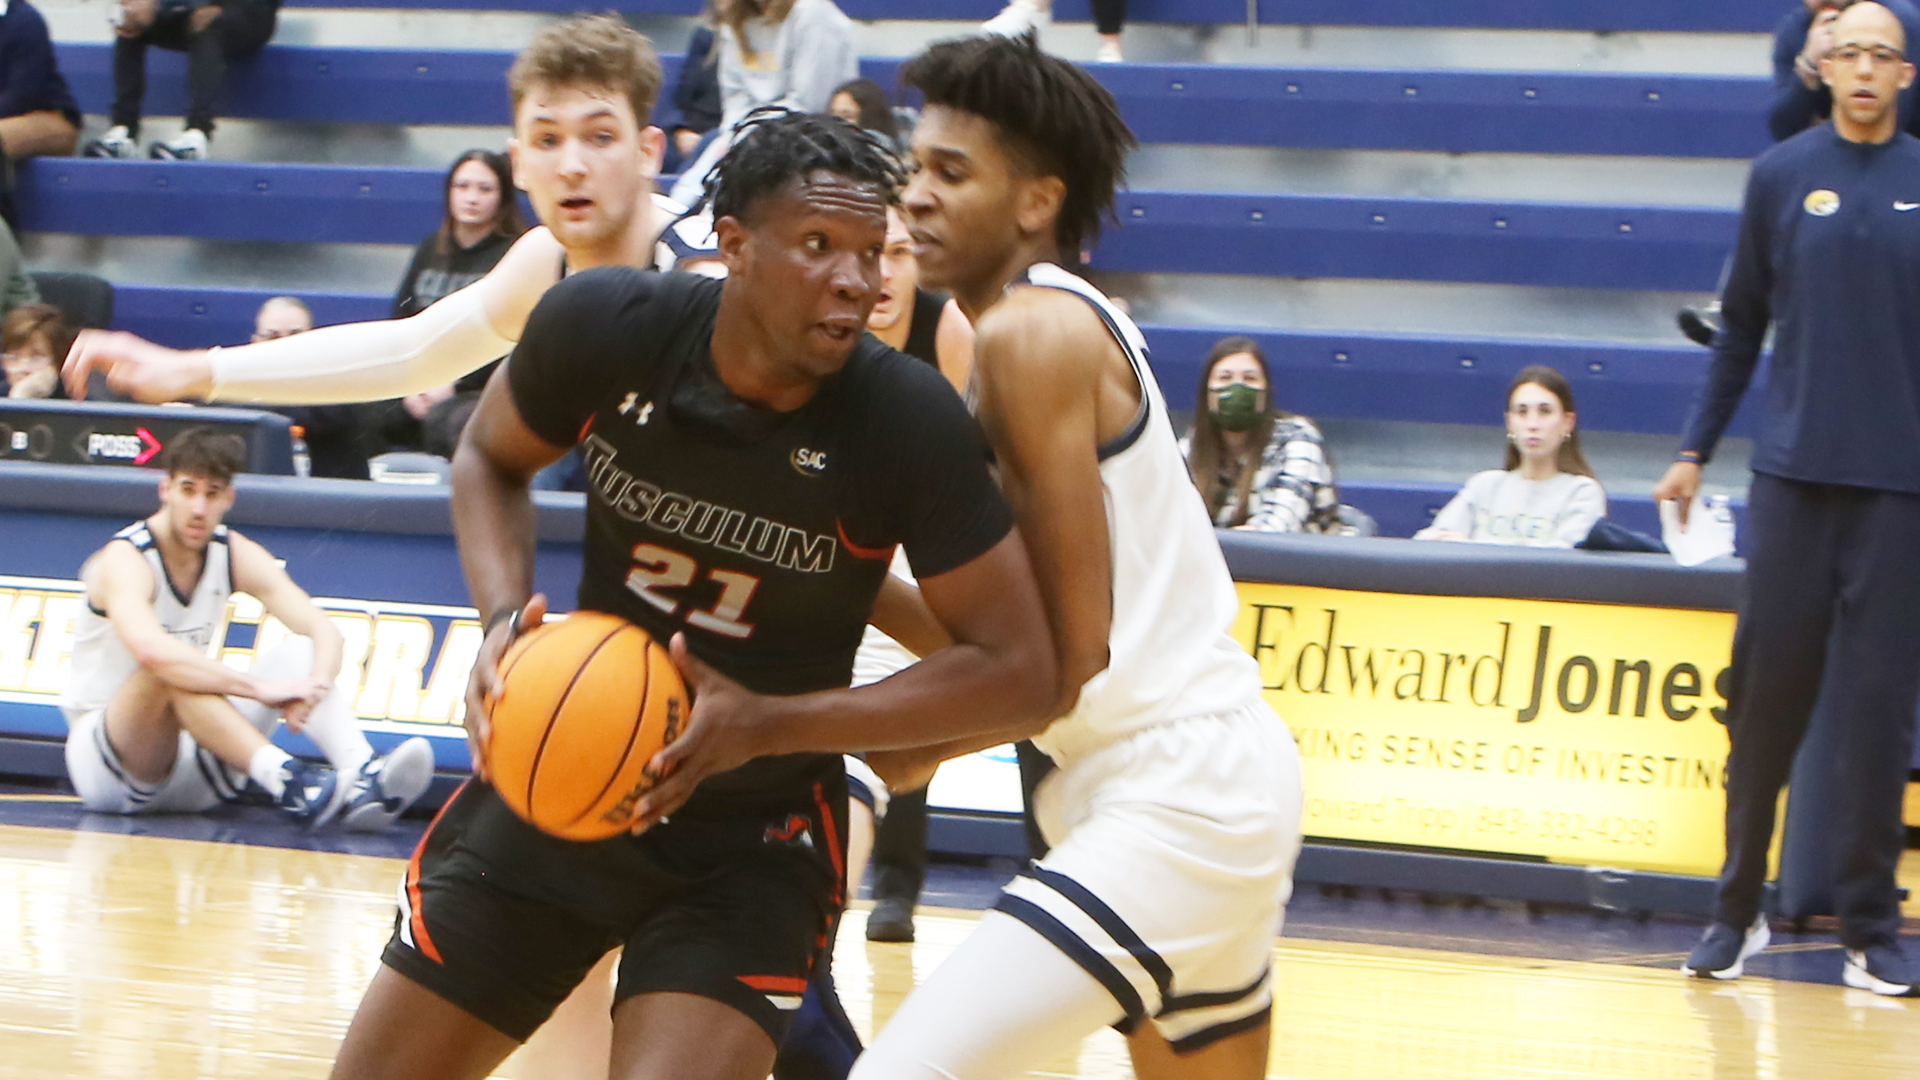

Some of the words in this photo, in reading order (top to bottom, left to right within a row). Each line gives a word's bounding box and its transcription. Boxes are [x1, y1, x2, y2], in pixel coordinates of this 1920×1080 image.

[88, 433, 142, 458] POSS
[796, 449, 827, 470] SAC
[583, 432, 837, 573] TUSCULUM
[624, 542, 762, 640] 21
[207, 592, 484, 726] CBRA
[1249, 603, 1513, 708] Edward
[1381, 734, 1490, 771] SENSE
[1503, 744, 1545, 775] OF
[1303, 794, 1388, 823] oward
